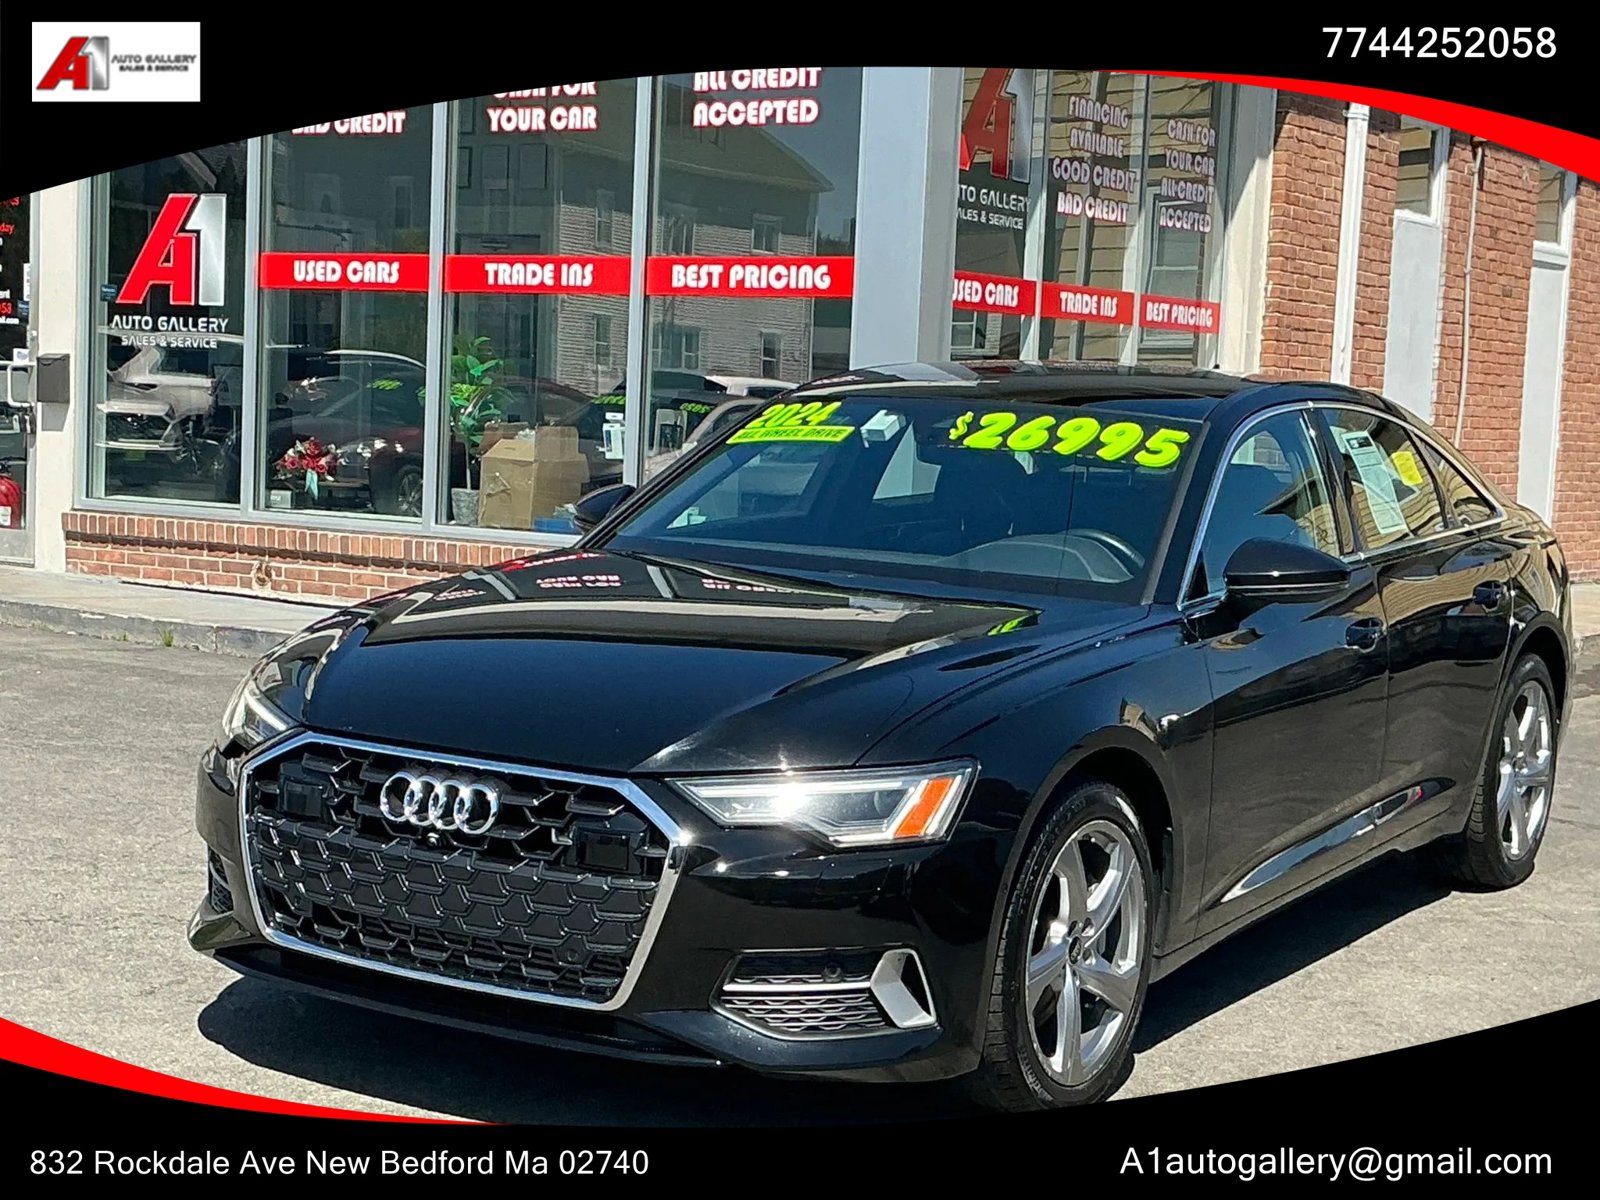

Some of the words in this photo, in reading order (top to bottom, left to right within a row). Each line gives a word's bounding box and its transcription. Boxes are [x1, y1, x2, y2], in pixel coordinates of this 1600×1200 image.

[693, 71, 727, 91] ALL
[731, 67, 822, 90] CREDIT
[334, 110, 406, 134] CREDIT
[486, 106, 547, 132] YOUR
[550, 106, 597, 130] CAR
[693, 99, 819, 127] ACCEPTED
[1069, 96, 1129, 128] FINANCING
[1070, 128, 1124, 158] AVAILABLE
[1167, 119, 1194, 142] CASH
[1195, 126, 1215, 147] FOR
[1053, 157, 1090, 183] GOOD
[1093, 165, 1136, 193] CREDIT
[1165, 148, 1192, 171] YOUR
[1194, 156, 1215, 176] CAR
[980, 189, 1032, 212] GALLERY
[1161, 177, 1176, 197] ALL
[1177, 183, 1214, 203] CREDIT
[980, 210, 987, 222] &
[988, 212, 1023, 230] SERVICE
[1057, 191, 1083, 216] BAD
[1085, 196, 1129, 223] CREDIT
[1159, 207, 1212, 233] ACCEPTED
[115, 193, 227, 306] A1
[294, 260, 342, 282] USED
[346, 260, 400, 284] CARS
[484, 262, 555, 286] TRADE
[561, 263, 594, 287] INS
[672, 264, 724, 288] BEST
[729, 264, 831, 290] PRICING
[985, 282, 1019, 307] CARS
[1060, 291, 1097, 316] TRADE
[1100, 296, 1118, 318] INS
[111, 315, 153, 331] AUTO
[157, 316, 229, 333] GALLERY
[1146, 302, 1170, 323] BEST
[1171, 304, 1213, 328] PRICING
[121, 335, 156, 346] SALES
[158, 335, 167, 347] &
[170, 337, 218, 349] SERVICE
[744, 401, 842, 429] 2024
[803, 429, 844, 438] DRIVE
[949, 411, 1191, 468] $26995
